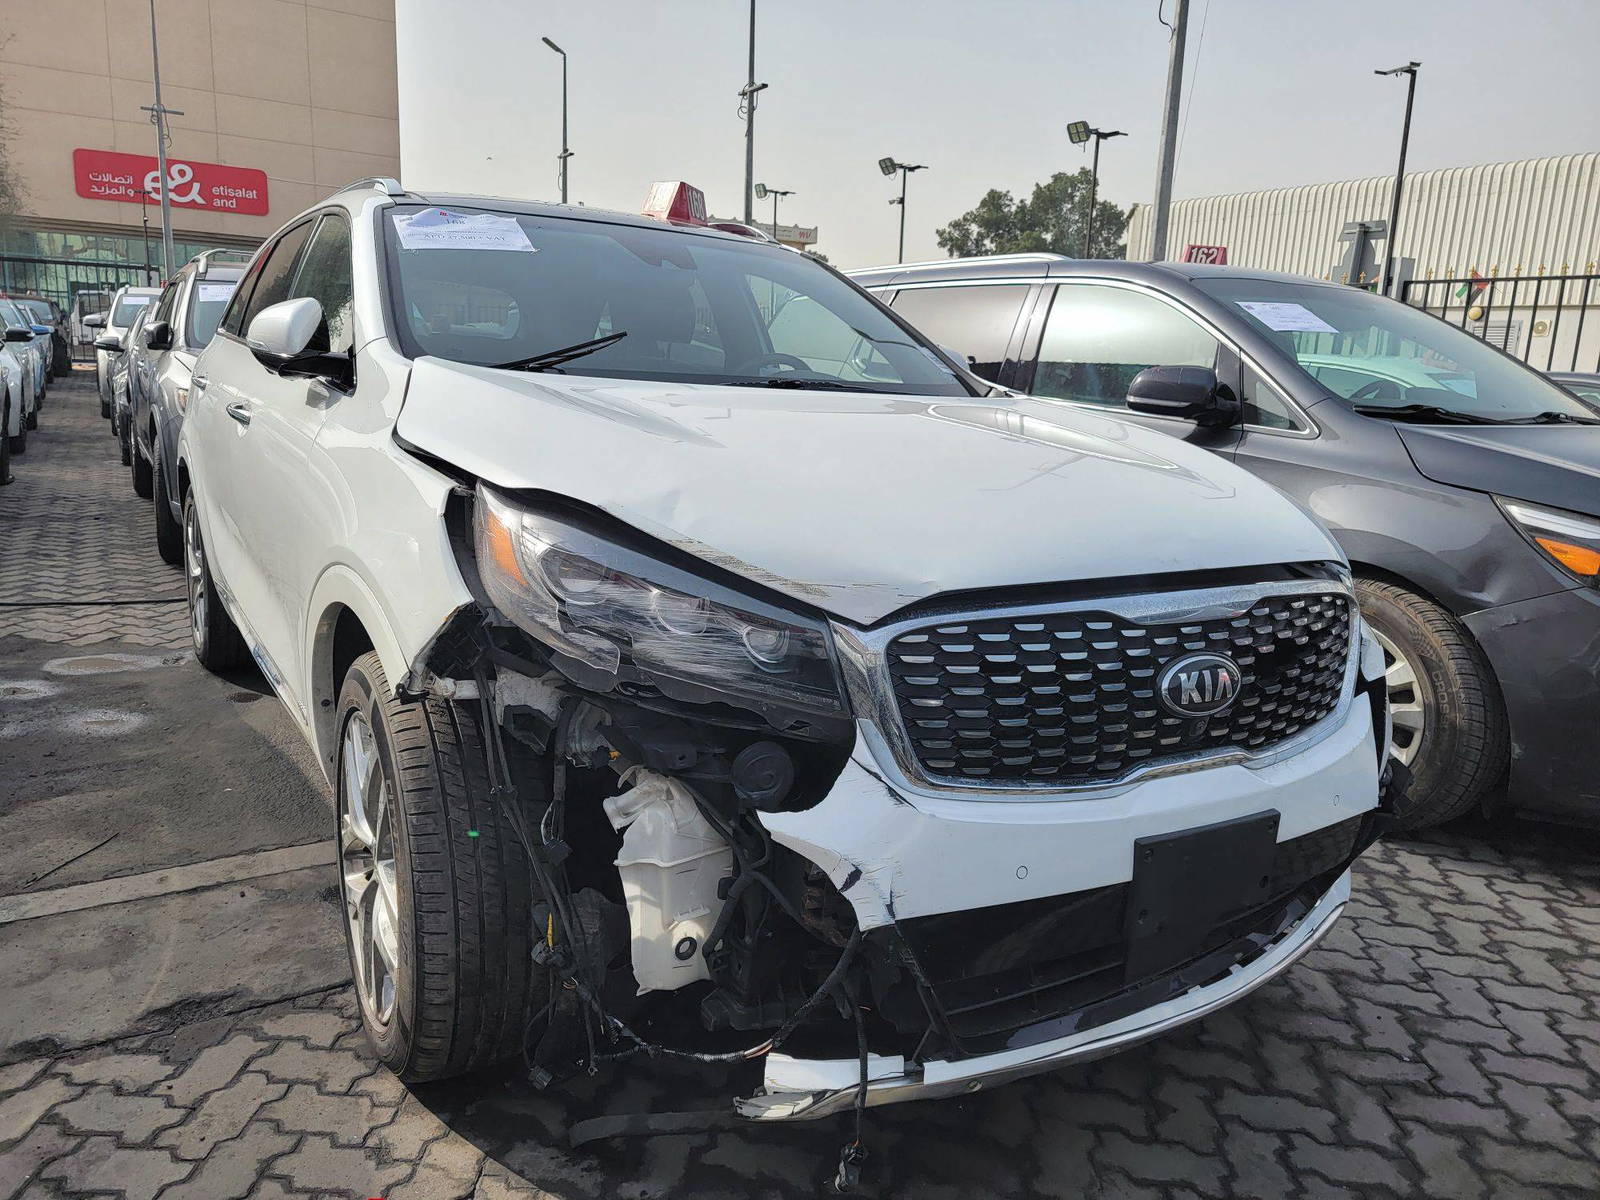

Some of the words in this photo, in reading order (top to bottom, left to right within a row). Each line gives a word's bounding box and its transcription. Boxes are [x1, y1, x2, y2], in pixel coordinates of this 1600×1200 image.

[89, 172, 133, 184] اتصالات
[211, 185, 258, 200] etisalat
[212, 197, 237, 209] and
[688, 189, 705, 221] 168
[1190, 247, 1218, 265] 162
[1178, 667, 1234, 705] KIA
